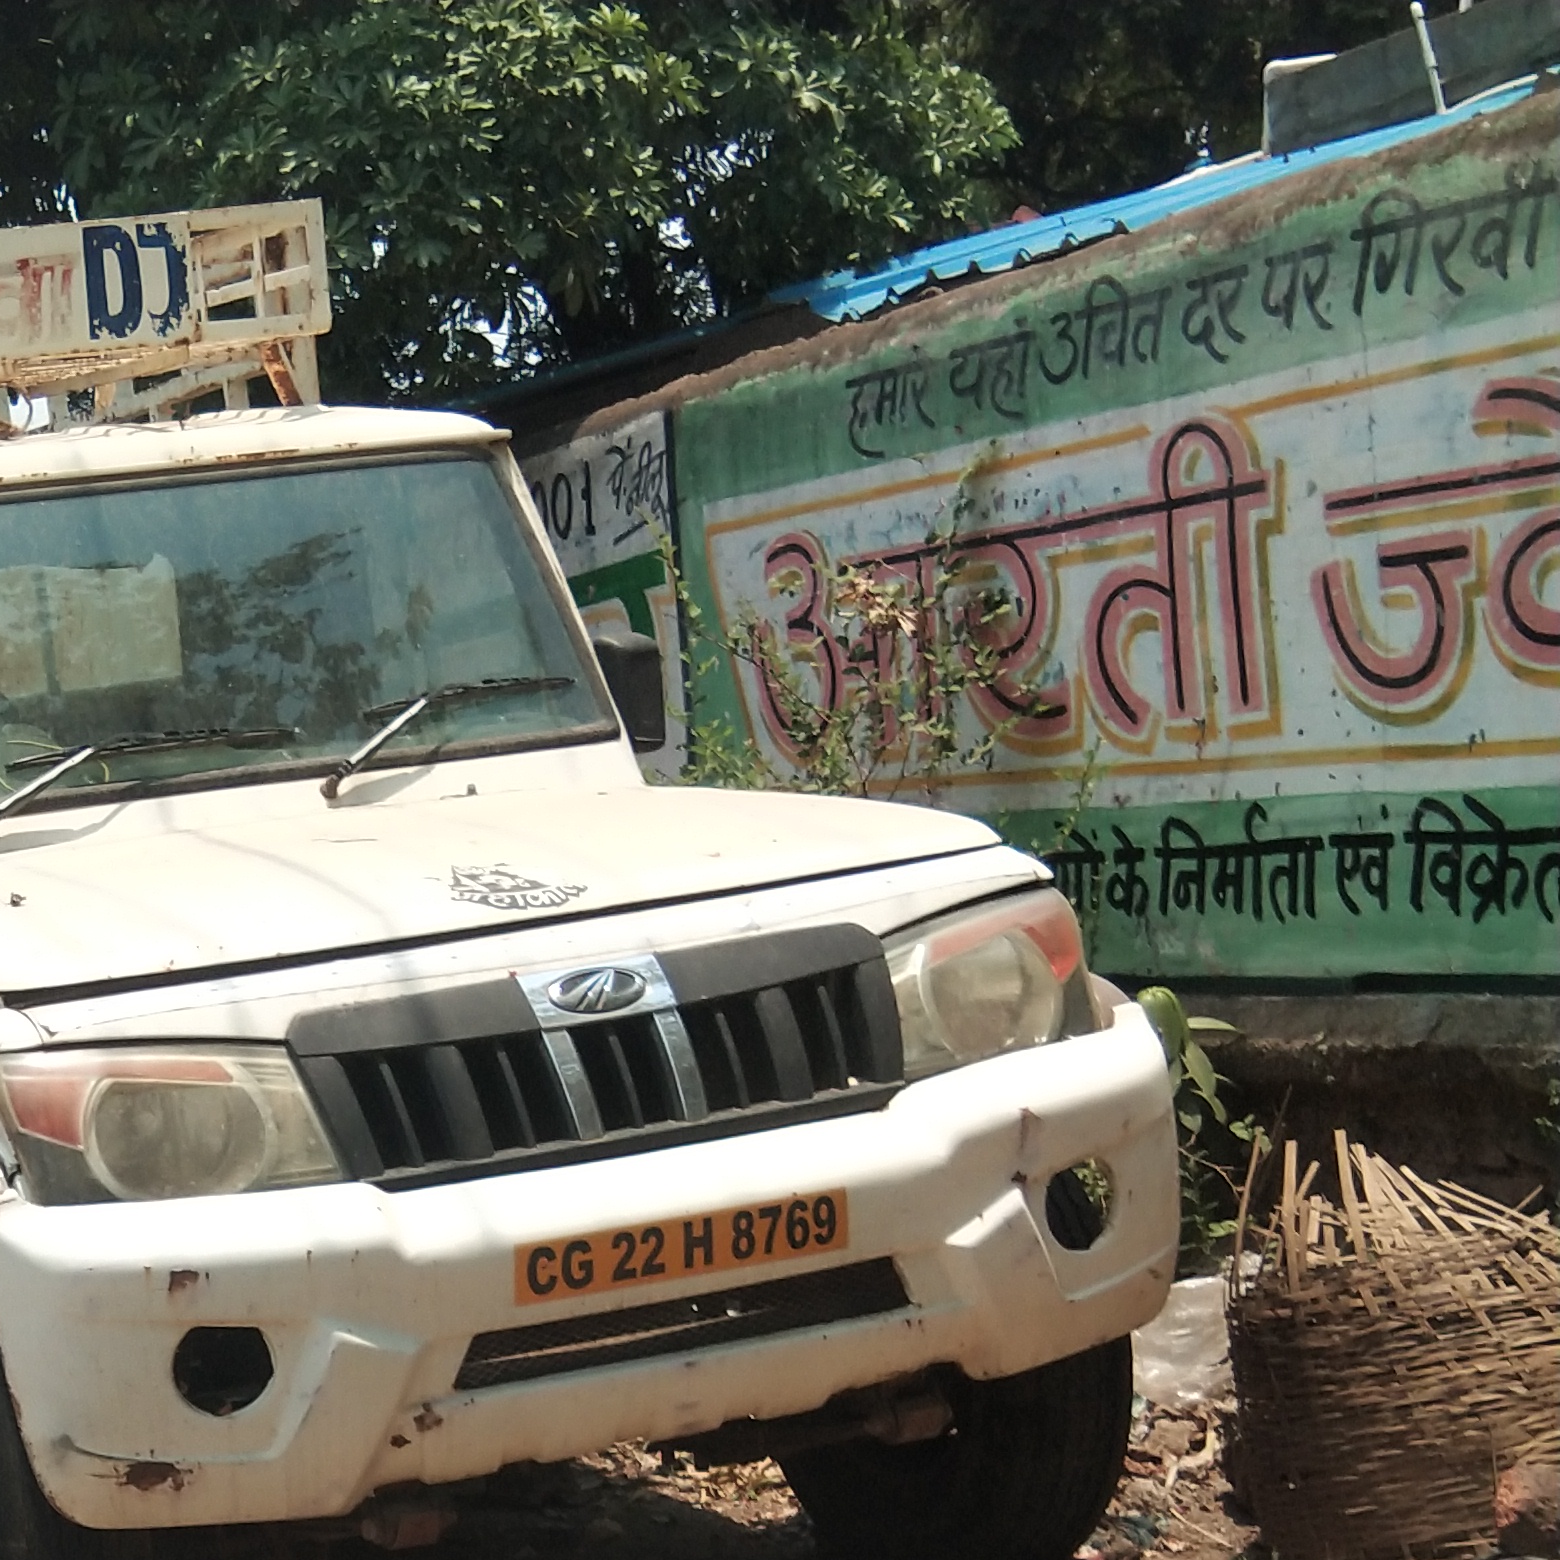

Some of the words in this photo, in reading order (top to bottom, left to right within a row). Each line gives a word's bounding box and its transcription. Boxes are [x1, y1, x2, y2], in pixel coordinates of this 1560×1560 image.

[82, 222, 190, 341] DJ
[948, 316, 1037, 420] यहां
[1181, 263, 1249, 364] दर
[1261, 240, 1335, 330] पर
[1350, 160, 1559, 317] गिरवी
[752, 415, 1284, 768] आरती
[1106, 824, 1150, 917] के
[1153, 801, 1324, 923] निर्माता
[1329, 804, 1394, 916] एवं
[526, 1240, 594, 1295] CG
[611, 1227, 666, 1283] 22
[683, 1217, 713, 1268] H
[731, 1195, 837, 1260] 8769
